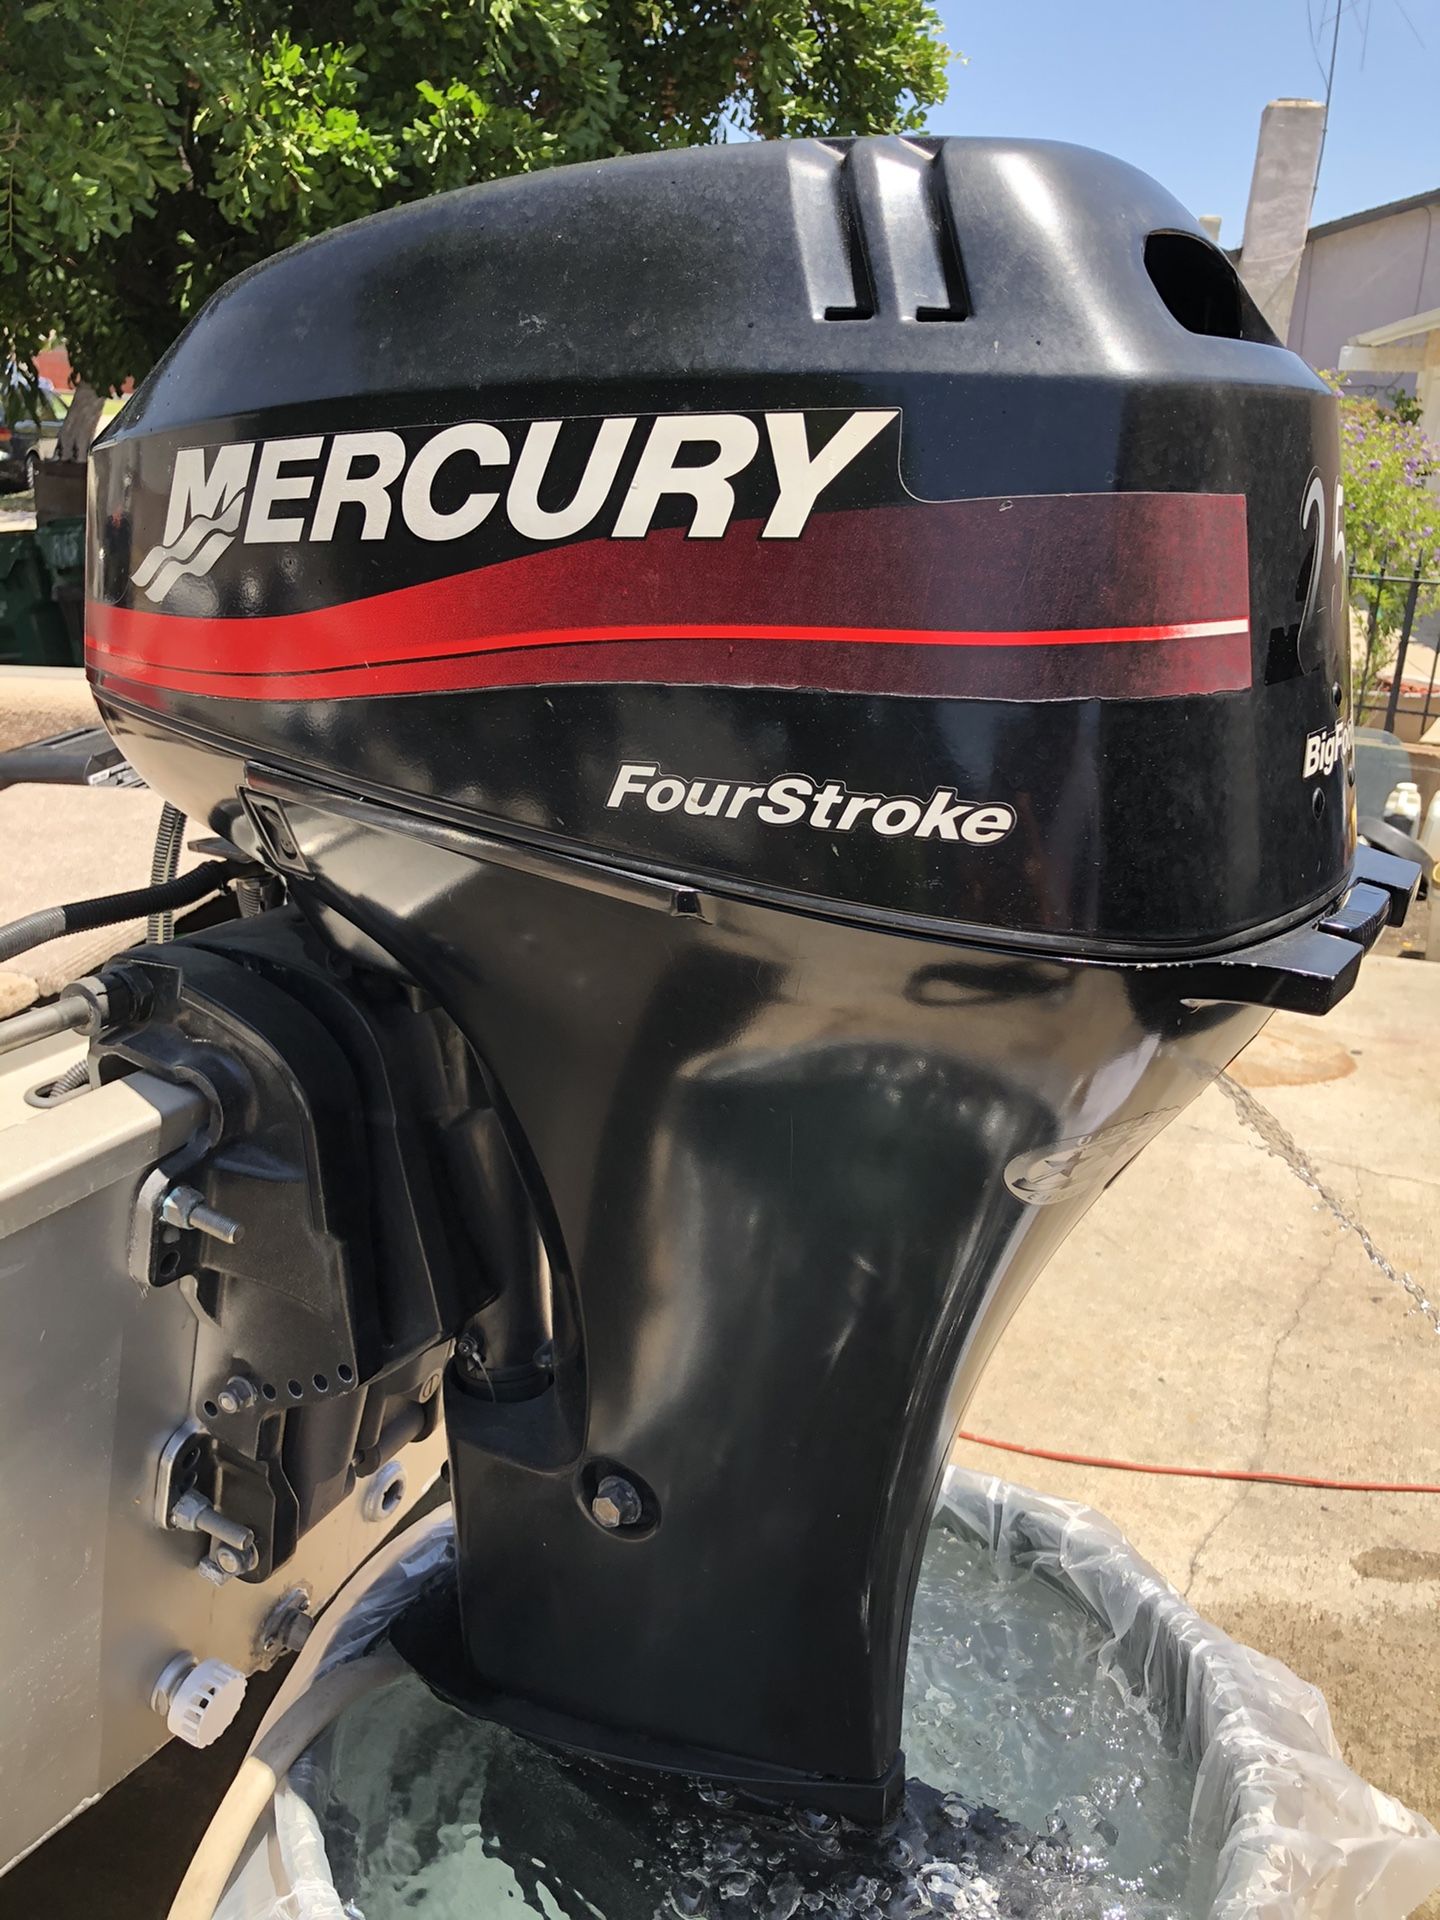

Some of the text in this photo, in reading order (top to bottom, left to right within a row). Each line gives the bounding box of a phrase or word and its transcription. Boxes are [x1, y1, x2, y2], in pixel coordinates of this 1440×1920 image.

[131, 410, 901, 602] MERCURY
[1298, 476, 1347, 664] 25
[606, 764, 1014, 844] FourStroke
